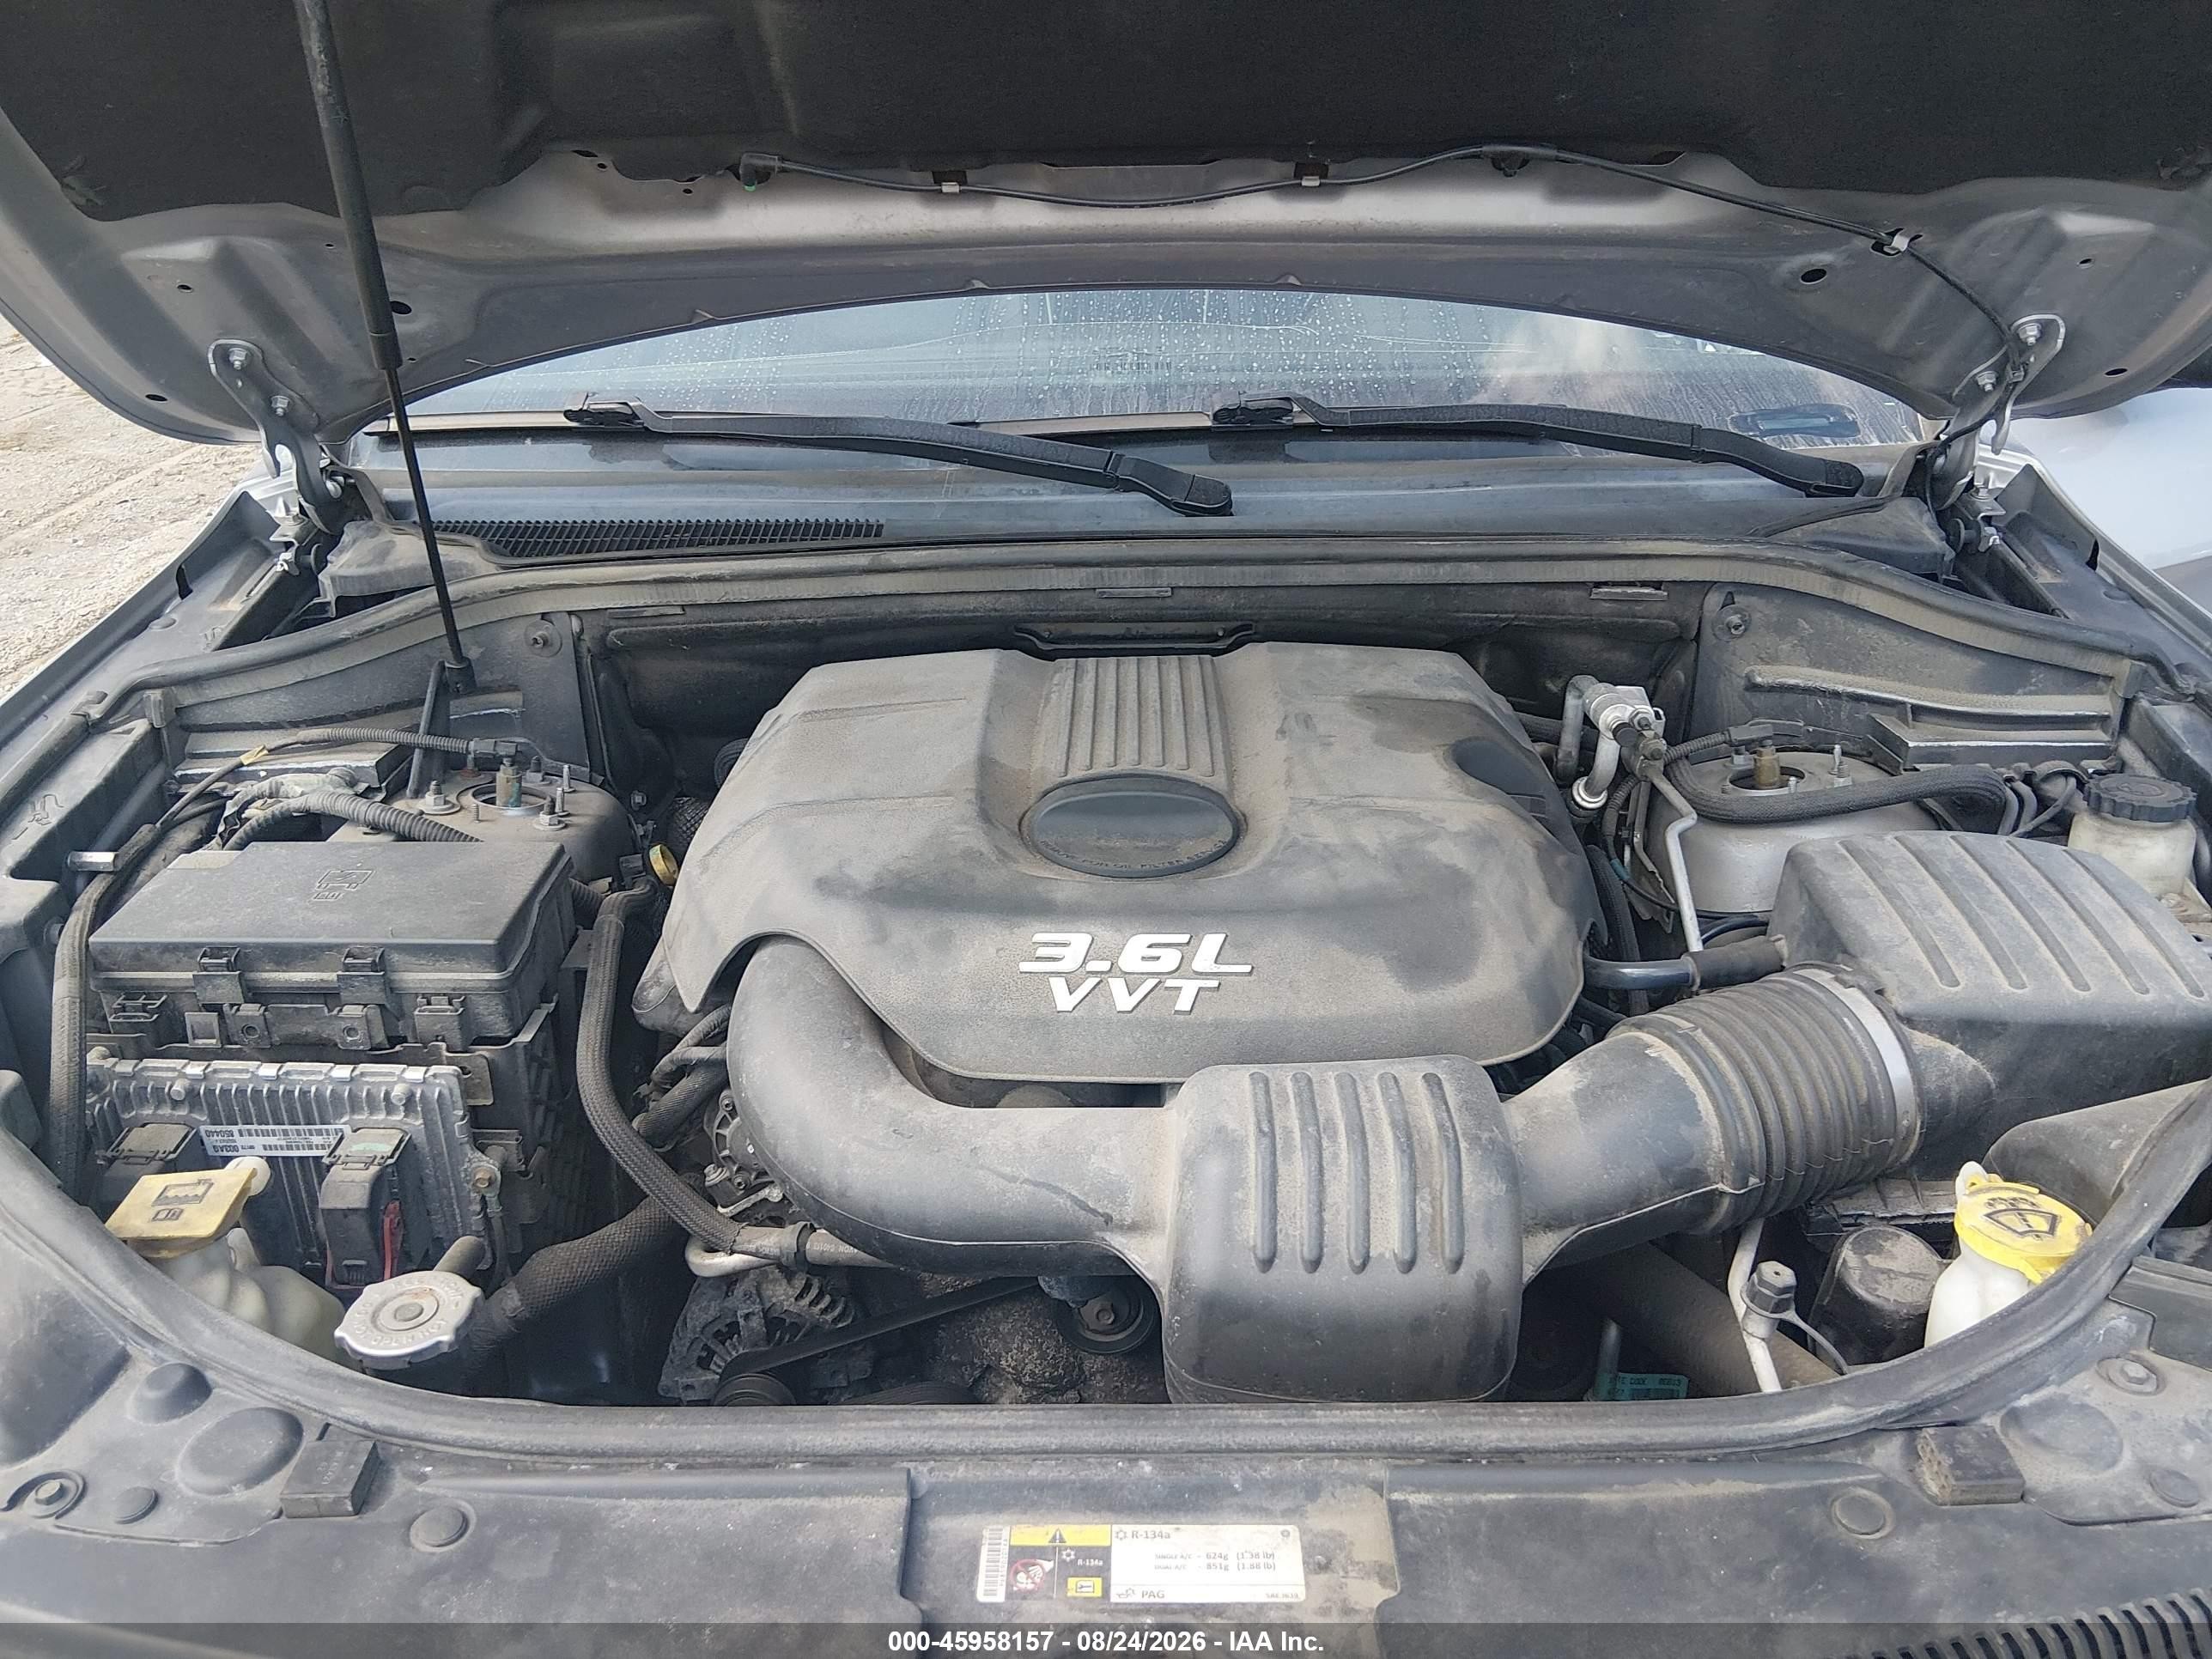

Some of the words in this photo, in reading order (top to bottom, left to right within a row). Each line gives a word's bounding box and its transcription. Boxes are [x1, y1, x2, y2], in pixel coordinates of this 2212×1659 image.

[1018, 932, 1255, 975] 3.6L
[1048, 976, 1221, 1015] VVT
[1131, 1529, 1171, 1540] R-134a
[1206, 1552, 1229, 1561] 624g
[1141, 1589, 1165, 1600] PAG
